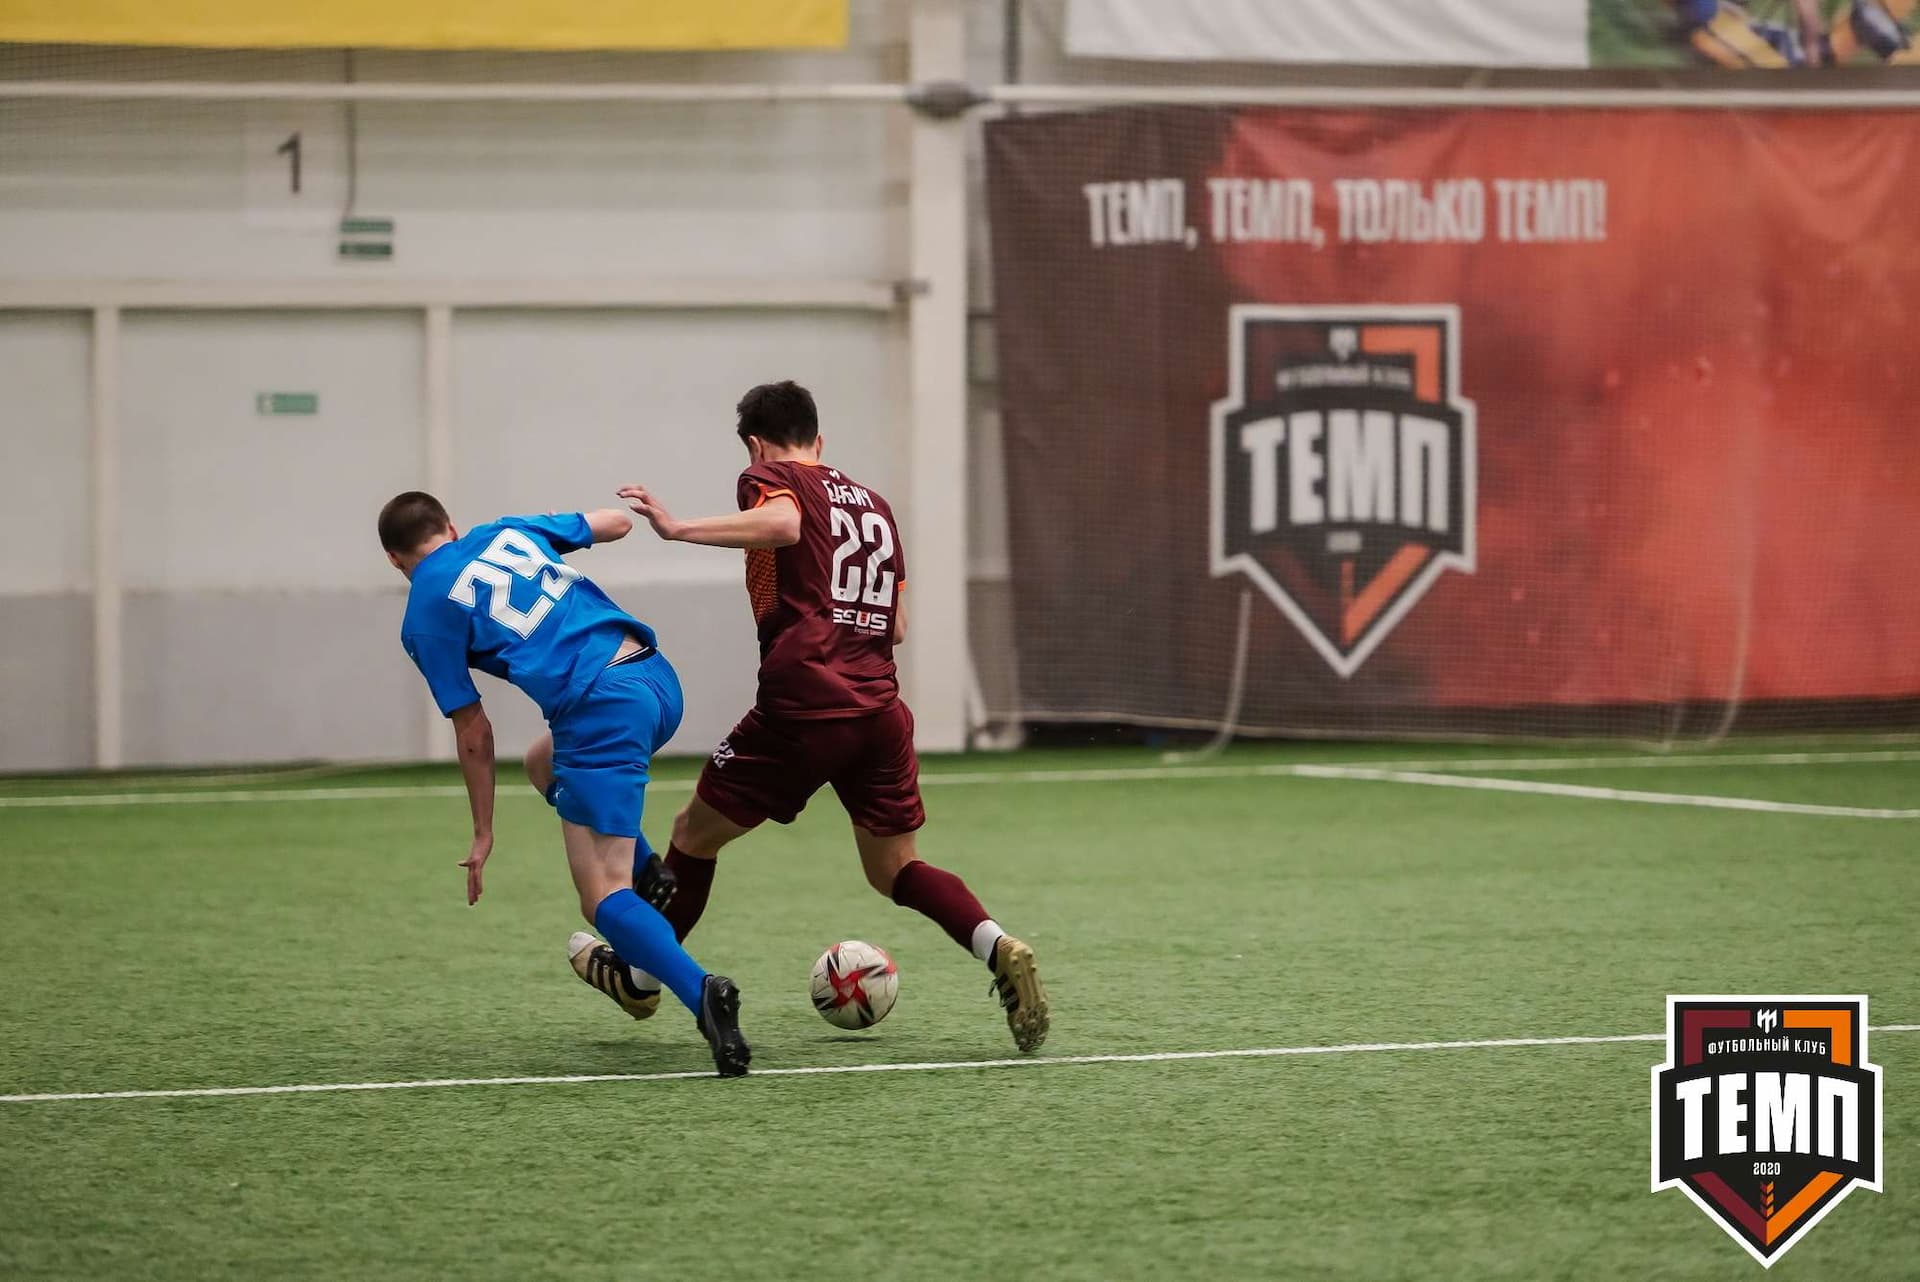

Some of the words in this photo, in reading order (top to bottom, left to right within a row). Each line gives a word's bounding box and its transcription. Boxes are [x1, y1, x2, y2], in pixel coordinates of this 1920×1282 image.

[276, 131, 301, 194] 1
[1082, 179, 1197, 250] ТЕМП,
[1206, 177, 1325, 250] ТЕМП,
[1333, 177, 1485, 244] ТОЛЬКО
[1493, 178, 1607, 243] ТЕМП!
[1240, 408, 1449, 536] ТЕМП
[448, 527, 585, 641] 29
[830, 507, 895, 608] 22
